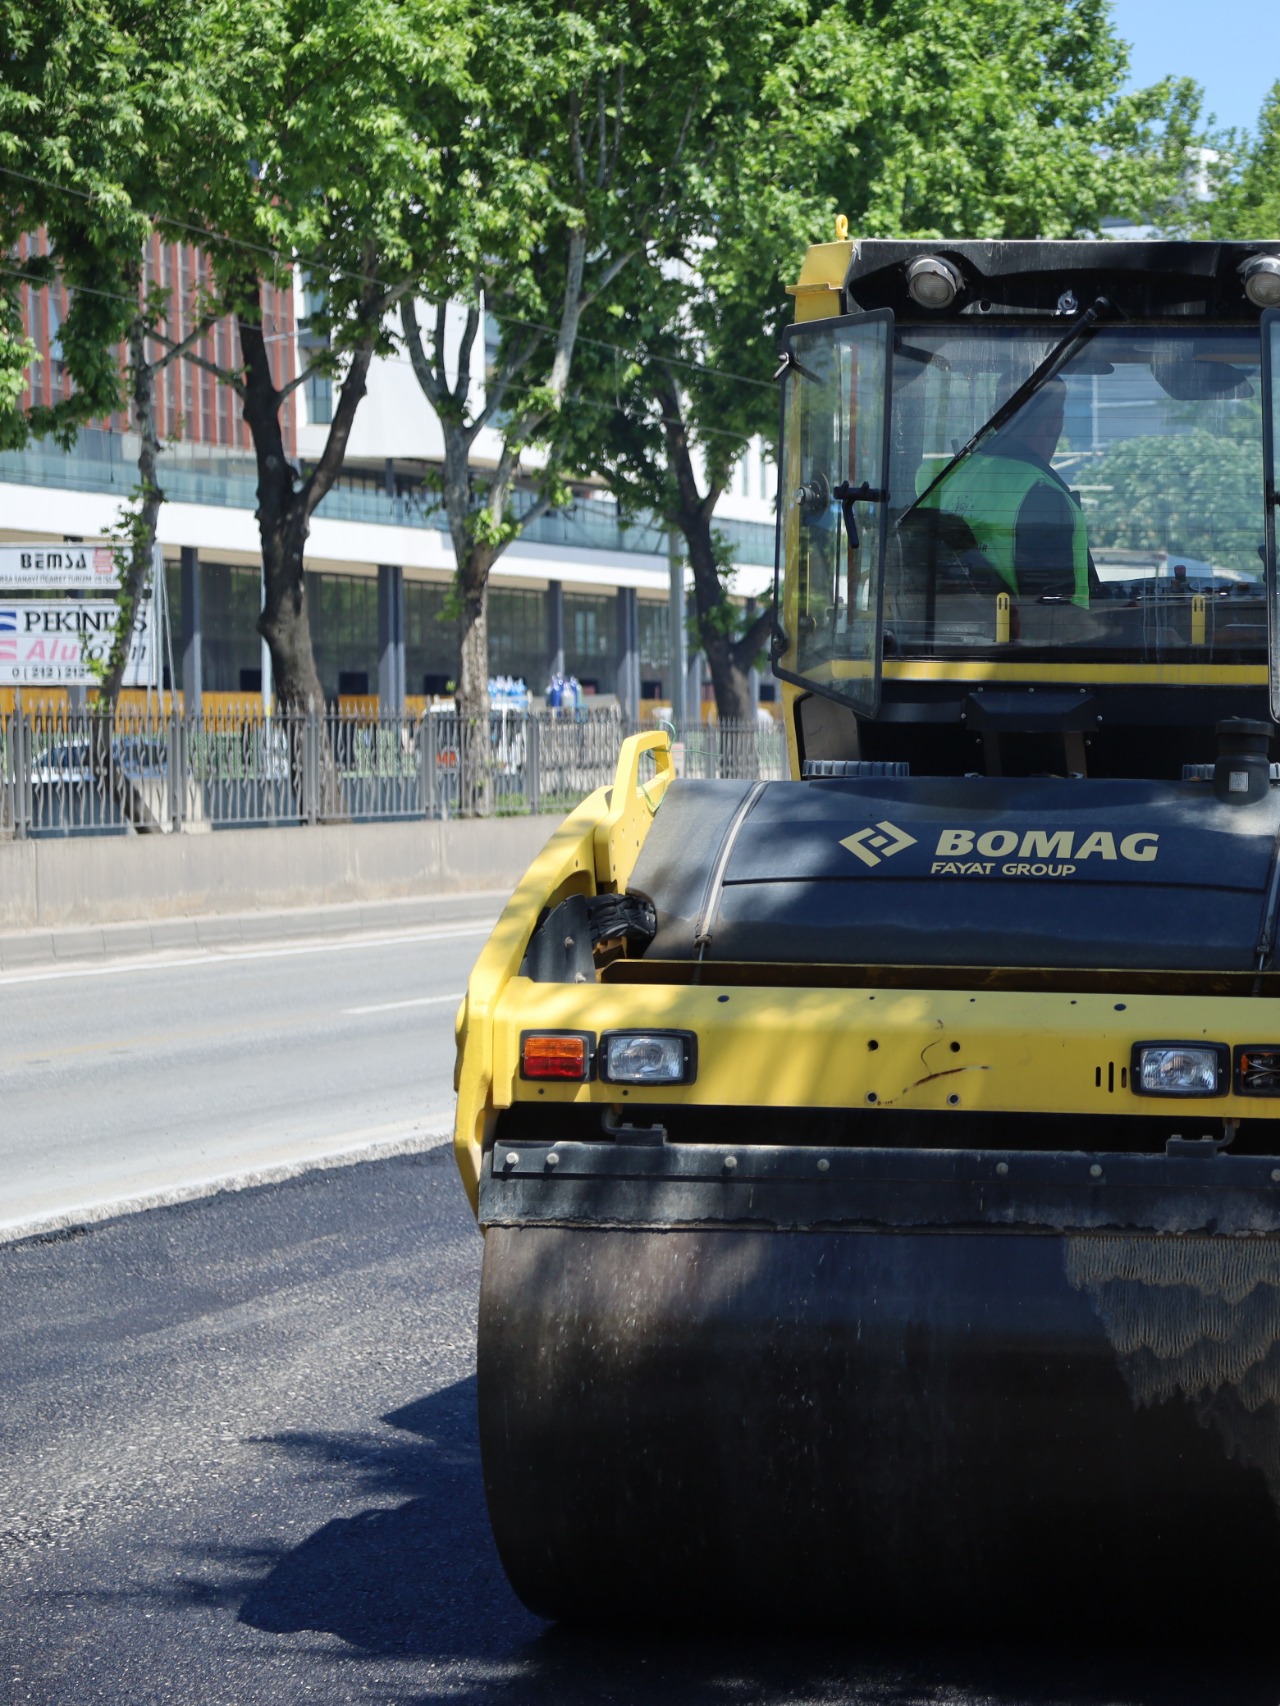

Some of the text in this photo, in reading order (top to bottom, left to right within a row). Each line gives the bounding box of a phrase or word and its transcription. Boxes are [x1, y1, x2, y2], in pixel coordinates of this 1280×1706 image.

[935, 829, 1160, 862] BOMAG
[930, 862, 1077, 877] FAYAT GROUP
